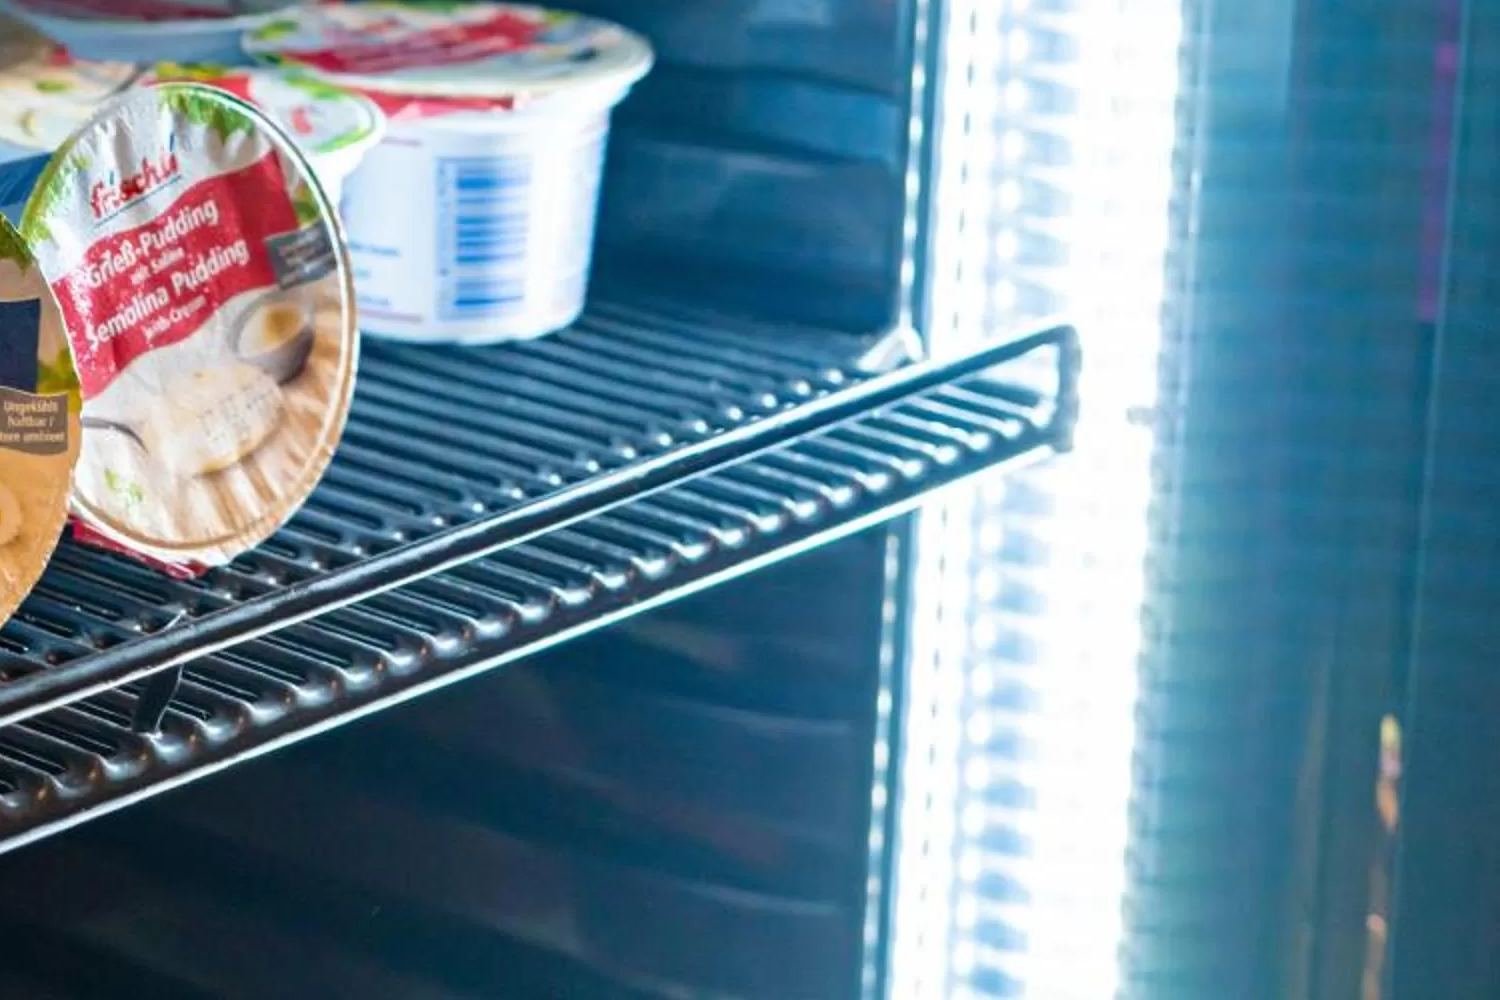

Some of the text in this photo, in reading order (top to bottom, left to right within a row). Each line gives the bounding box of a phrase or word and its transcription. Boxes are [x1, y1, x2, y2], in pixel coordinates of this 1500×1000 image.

[87, 199, 219, 288] Grieß-Pudding
[85, 286, 170, 352] Semolina
[170, 239, 250, 297] Pudding
